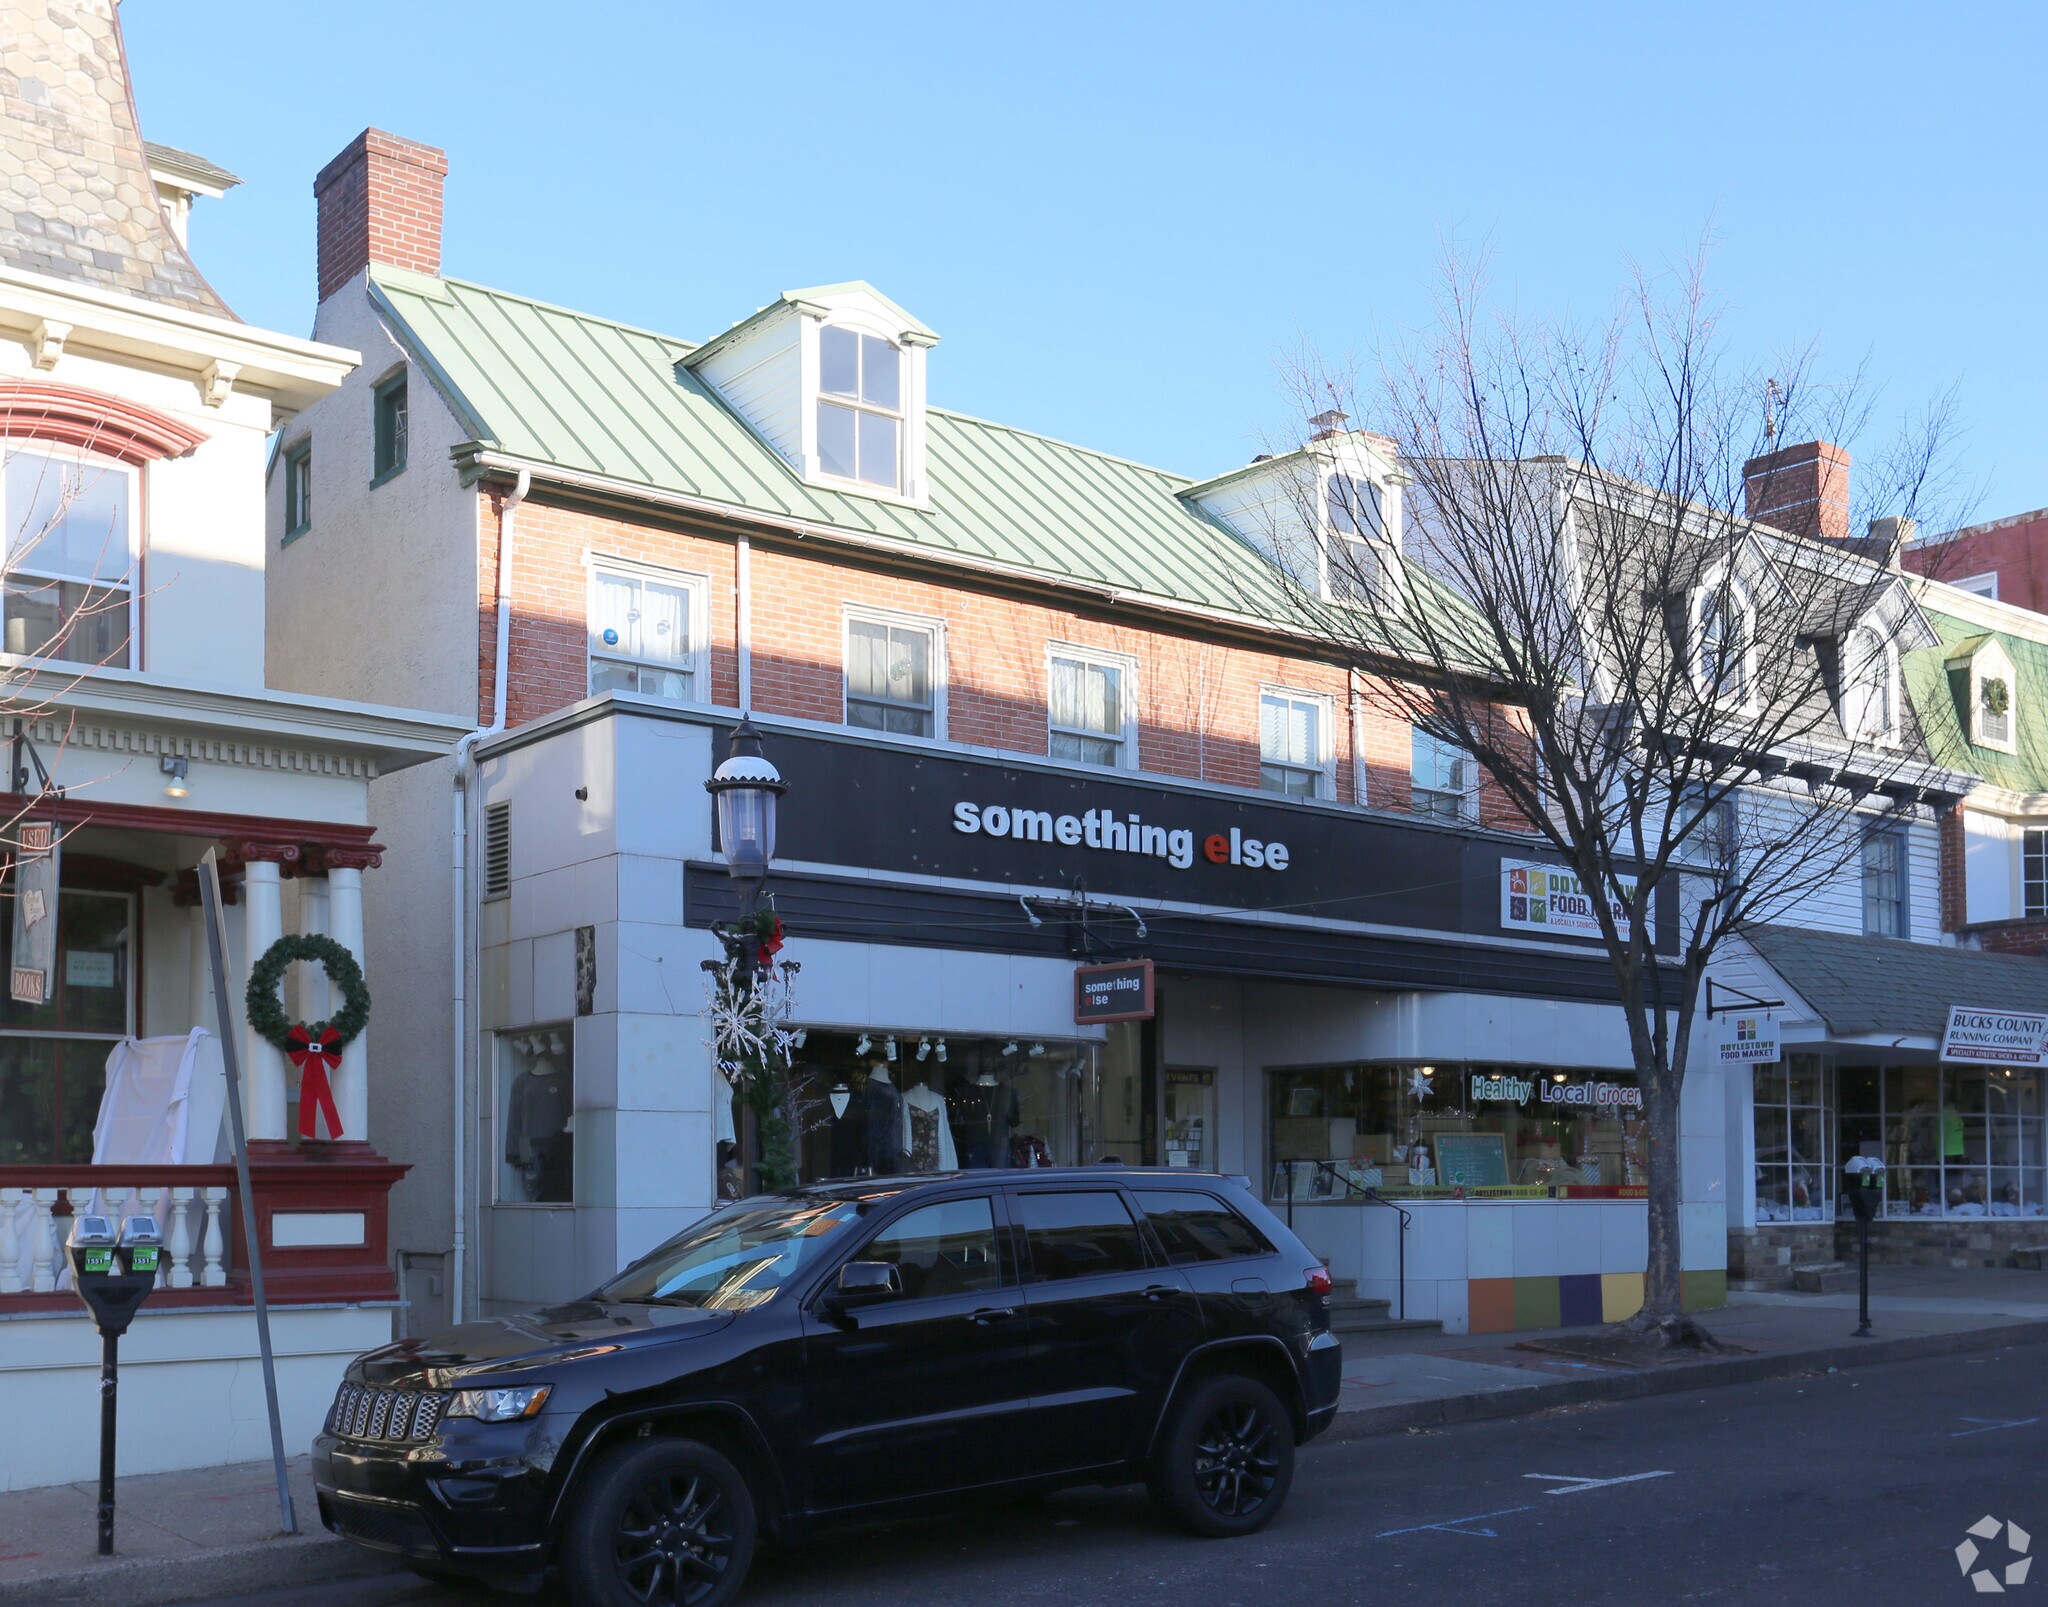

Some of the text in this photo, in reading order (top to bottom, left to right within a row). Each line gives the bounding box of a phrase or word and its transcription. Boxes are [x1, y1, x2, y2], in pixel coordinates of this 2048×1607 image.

[22, 827, 48, 849] USED
[953, 801, 1289, 871] something else
[1549, 894, 1586, 916] FOOD
[14, 972, 42, 998] BOOKS
[1085, 978, 1140, 993] something
[1085, 995, 1108, 1005] else
[1953, 1014, 2044, 1033] BUCKS COUNTY
[1721, 1041, 1774, 1051] DOYLESTOWN
[1949, 1030, 2033, 1046] RUNNING COMPANY
[1742, 1049, 1774, 1057] MARKET
[1472, 1075, 1532, 1107] Healthy
[1540, 1078, 1593, 1105] Local
[1619, 1189, 1634, 1197] FOOD
